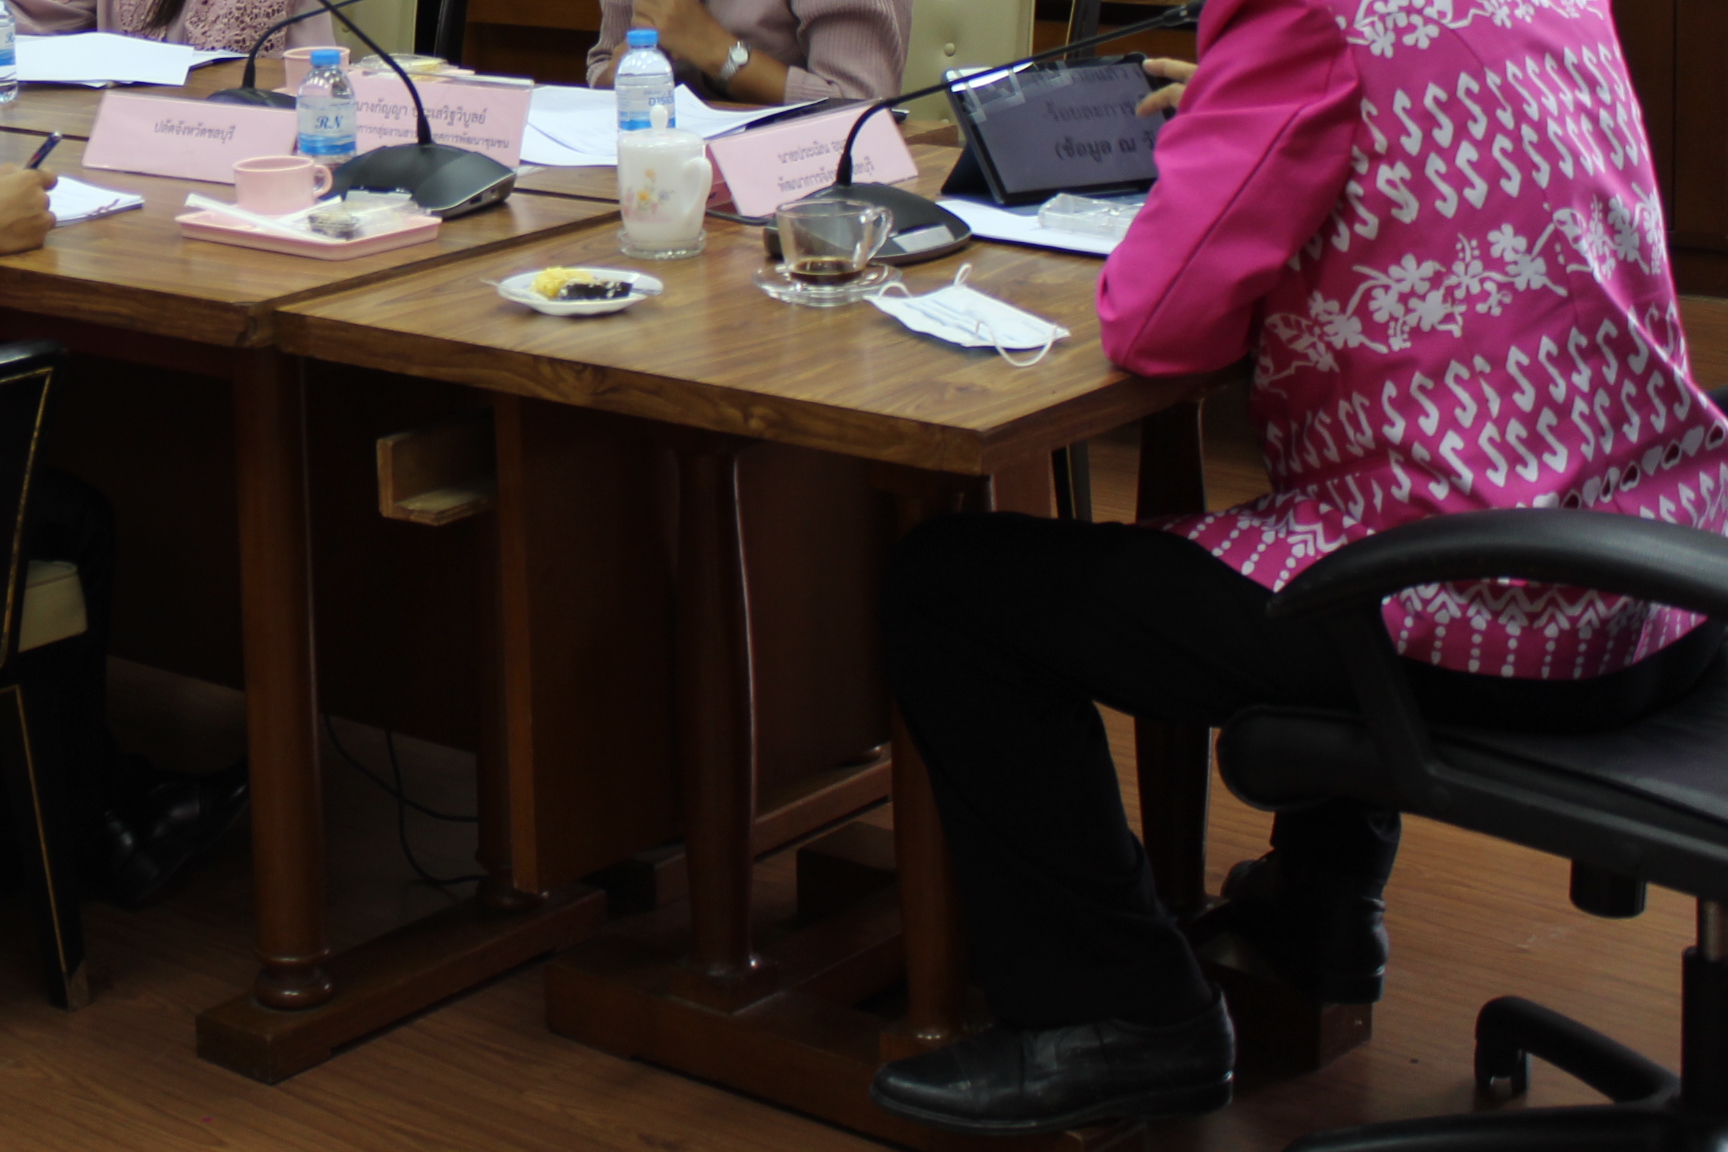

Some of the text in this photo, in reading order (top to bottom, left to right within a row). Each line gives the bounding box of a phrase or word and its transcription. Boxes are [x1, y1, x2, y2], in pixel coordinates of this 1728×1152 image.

[315, 115, 343, 129] RN
[413, 105, 487, 127] ปะเสริฐวิบูลย์
[154, 118, 234, 143] ปลัดจังหวัดชลบุรี
